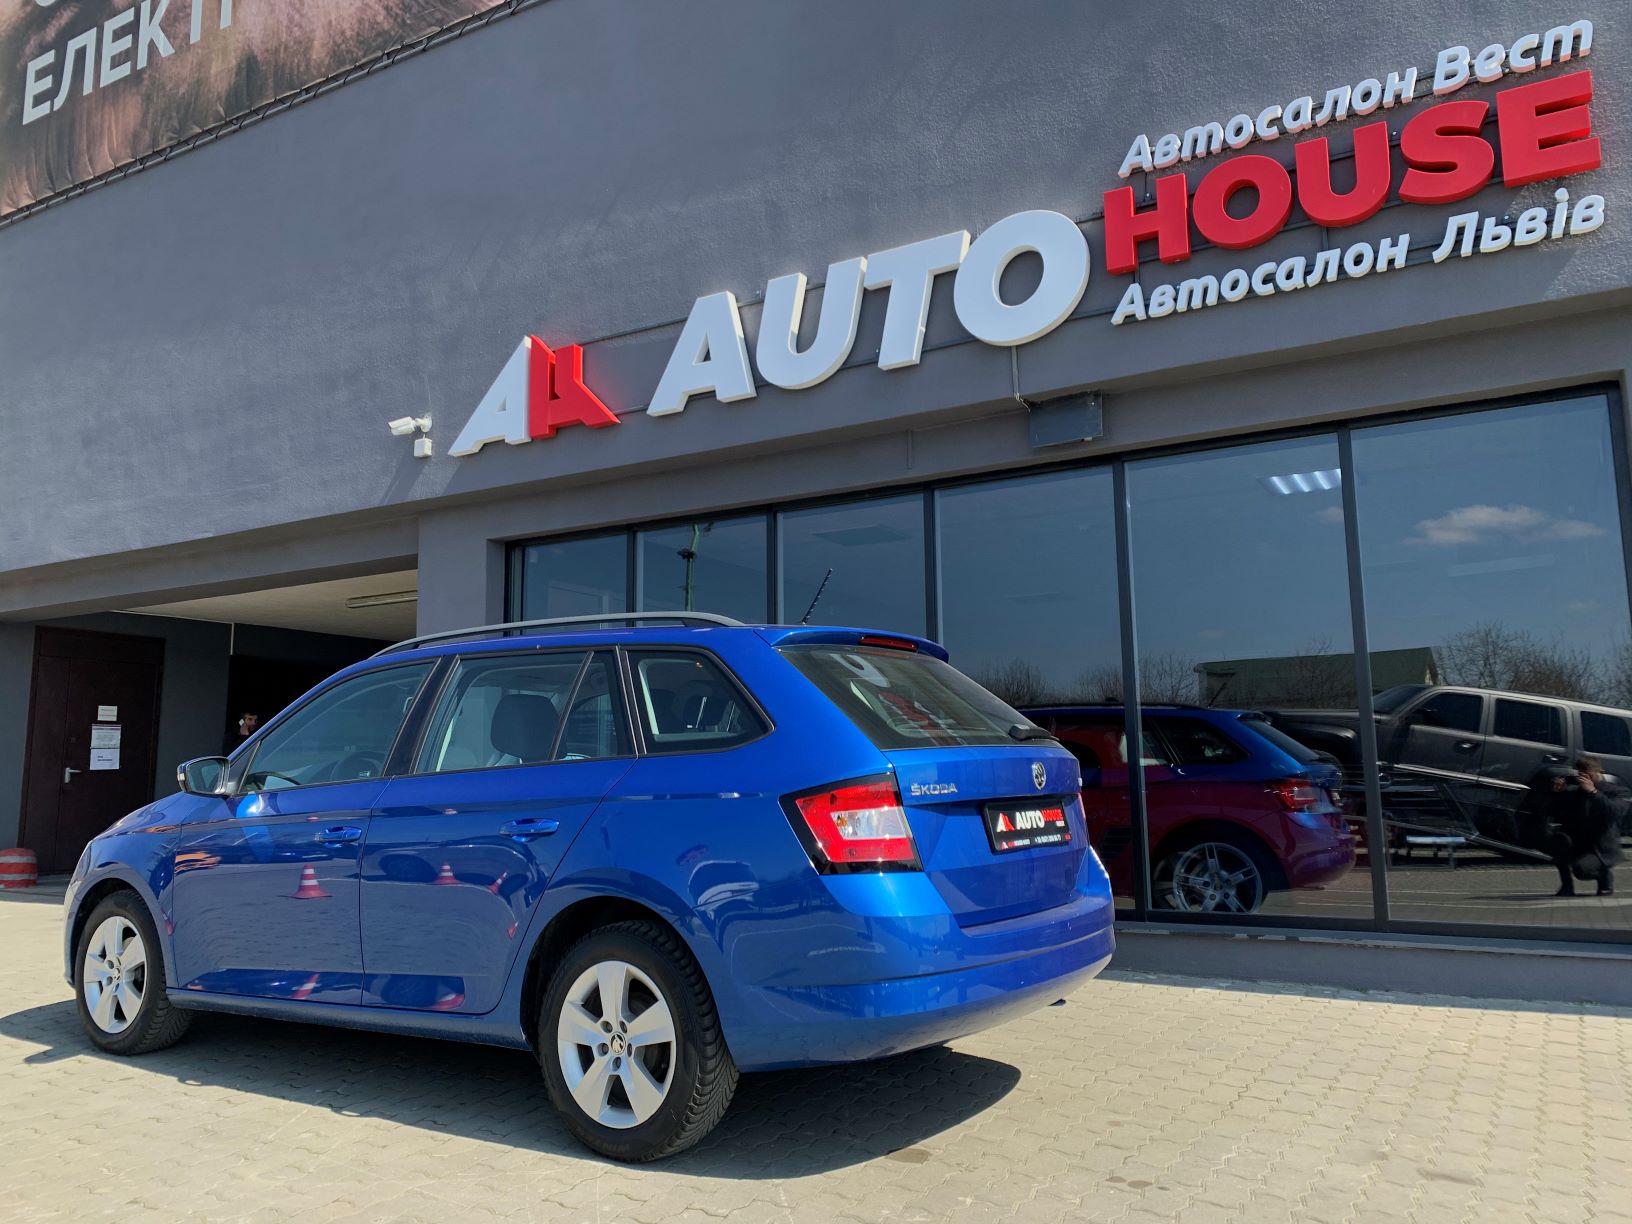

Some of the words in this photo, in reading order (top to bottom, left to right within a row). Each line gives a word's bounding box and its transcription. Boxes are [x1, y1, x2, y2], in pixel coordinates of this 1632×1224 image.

[1118, 67, 1418, 178] Автосалон
[1433, 19, 1594, 95] Вест
[647, 209, 1090, 417] AUTO
[1103, 70, 1602, 276] HOUSE
[1111, 234, 1410, 326] Автосалон
[1433, 187, 1606, 264] Львів
